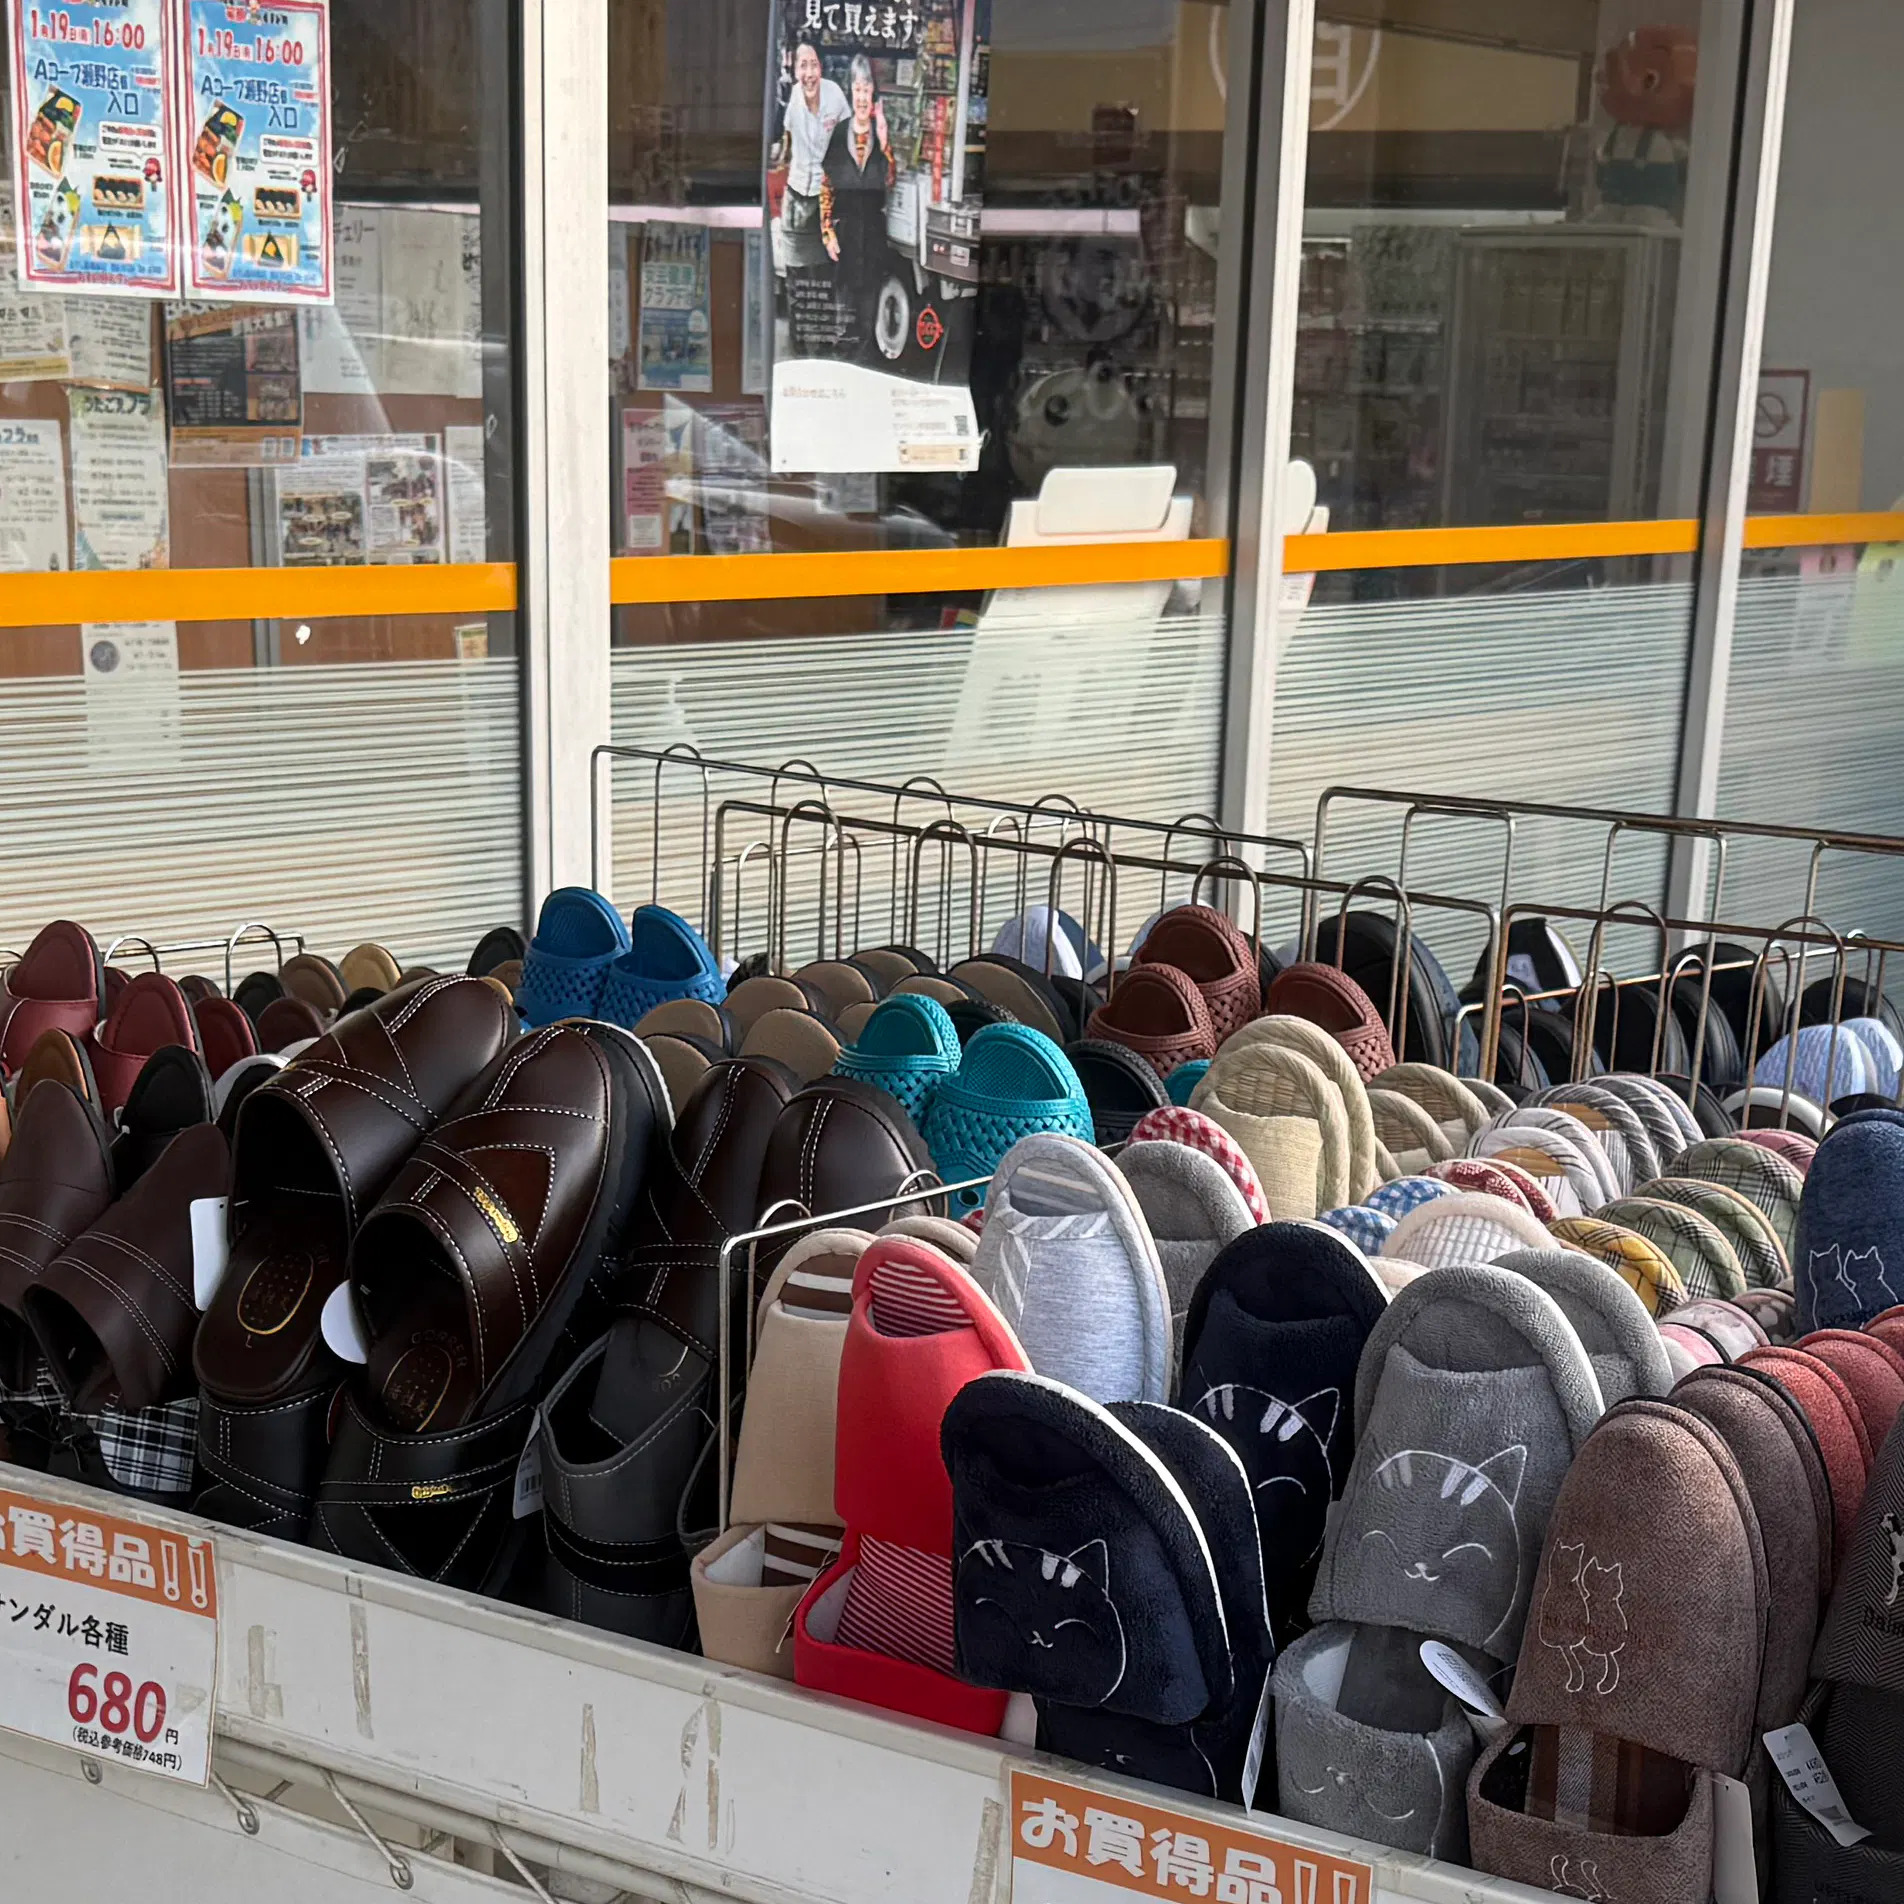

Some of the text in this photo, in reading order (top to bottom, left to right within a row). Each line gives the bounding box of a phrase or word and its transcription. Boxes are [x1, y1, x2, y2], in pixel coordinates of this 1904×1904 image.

[94, 19, 145, 50] 16:00
[800, 0, 923, 49] 見て買えます。
[256, 37, 303, 65] 16:00
[107, 91, 139, 115] 入口
[268, 105, 298, 129] 入口
